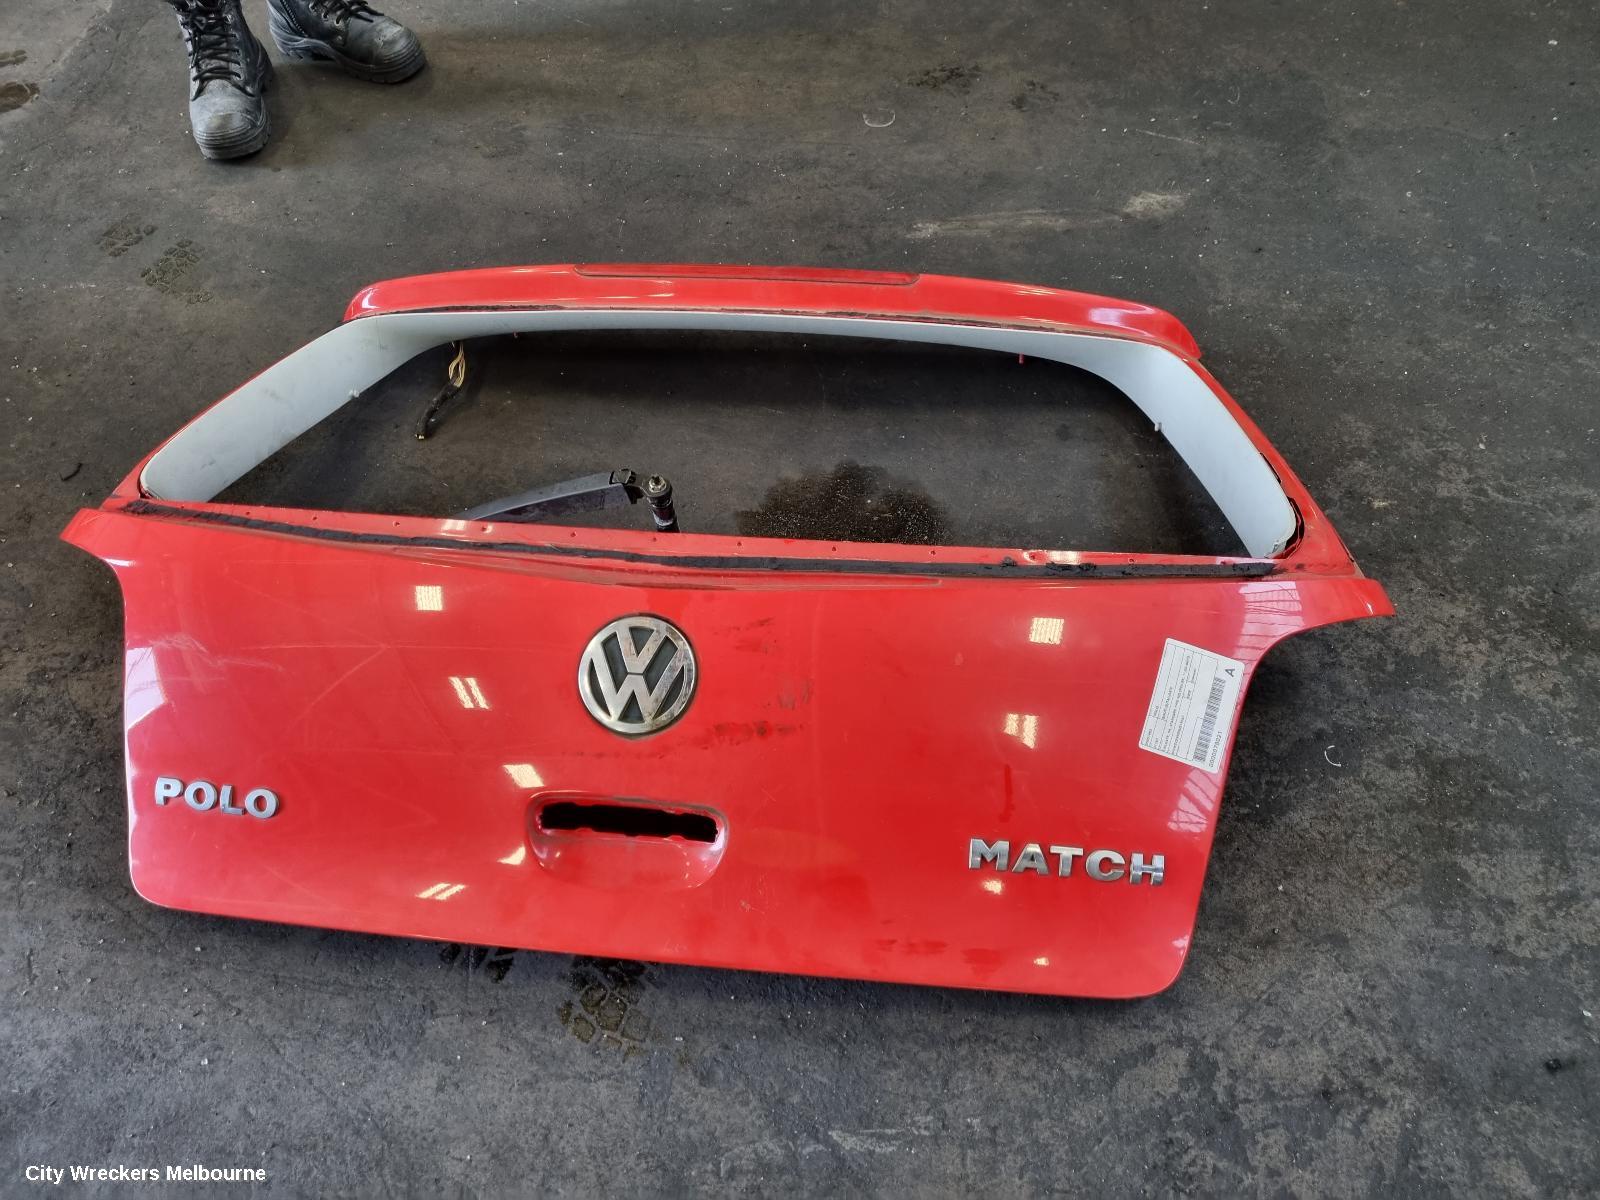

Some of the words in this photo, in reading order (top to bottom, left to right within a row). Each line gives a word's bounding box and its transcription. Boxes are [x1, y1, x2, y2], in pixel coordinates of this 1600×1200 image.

[1225, 667, 1236, 678] A
[154, 776, 279, 819] POLO
[968, 838, 1165, 886] MATCH
